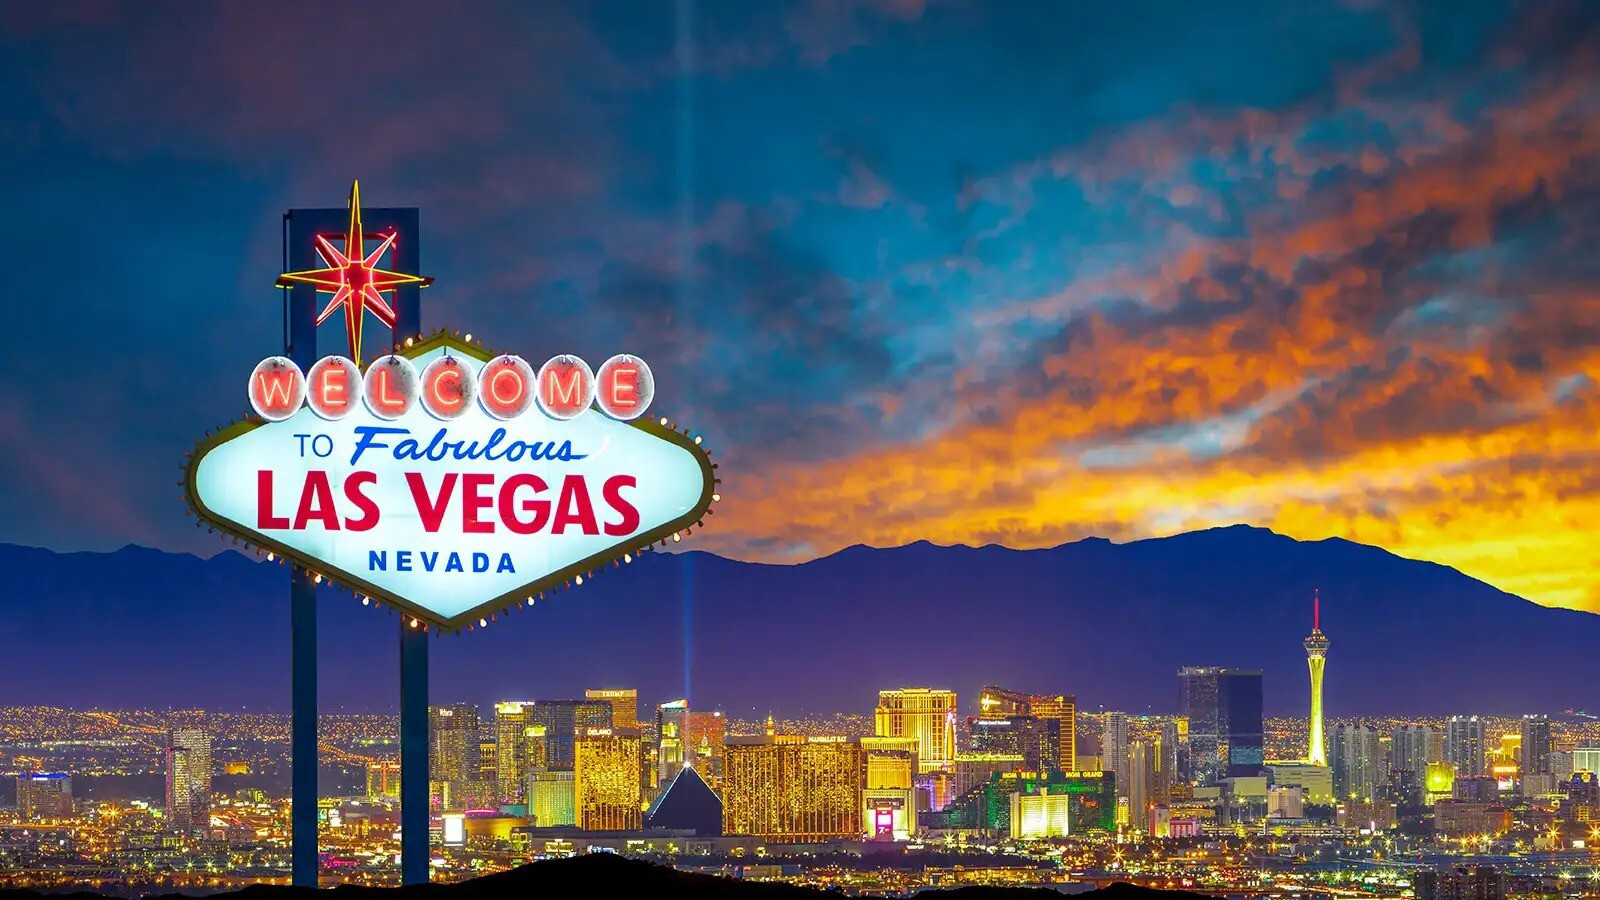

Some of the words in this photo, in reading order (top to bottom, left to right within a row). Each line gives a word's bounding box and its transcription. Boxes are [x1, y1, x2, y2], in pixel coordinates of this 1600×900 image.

[257, 368, 638, 408] WELCOME
[293, 433, 334, 458] TO
[350, 426, 588, 466] Fabulous
[257, 470, 380, 532] LAS
[404, 473, 640, 537] VEGAS
[368, 550, 516, 574] NEVADA
